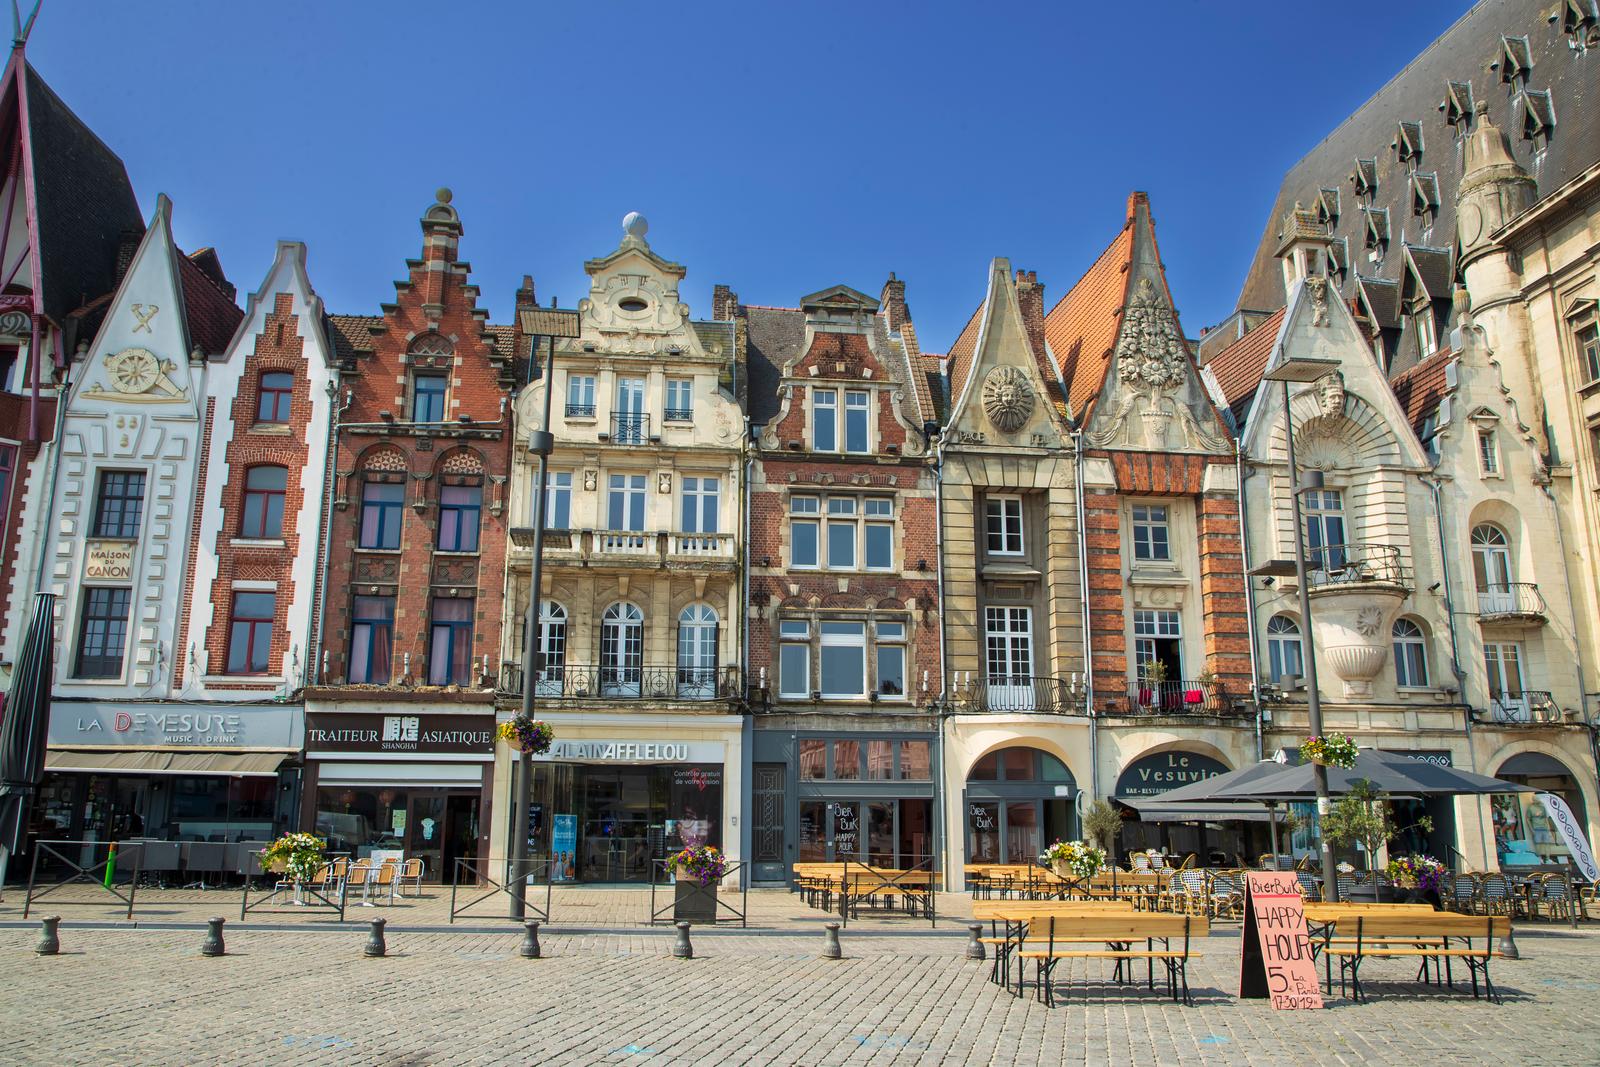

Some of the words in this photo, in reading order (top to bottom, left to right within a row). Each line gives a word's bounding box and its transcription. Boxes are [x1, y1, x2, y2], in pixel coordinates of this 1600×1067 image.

[87, 566, 130, 577] CANON
[77, 718, 103, 731] LA
[114, 712, 240, 733] DEMESURE
[164, 735, 193, 743] MUSIC
[206, 735, 236, 743] DRINK
[309, 729, 379, 743] TRAITEUR
[421, 731, 491, 744] ASIATIQUE
[382, 742, 418, 750] SHANGHAI
[553, 743, 606, 759] ALAIN
[600, 743, 689, 761] AFFLELOU
[1168, 754, 1189, 767] Le
[835, 833, 856, 842] HAPPY
[1255, 907, 1303, 928] HAPPY
[1265, 934, 1315, 961] HOUR
[1291, 970, 1305, 981] La
